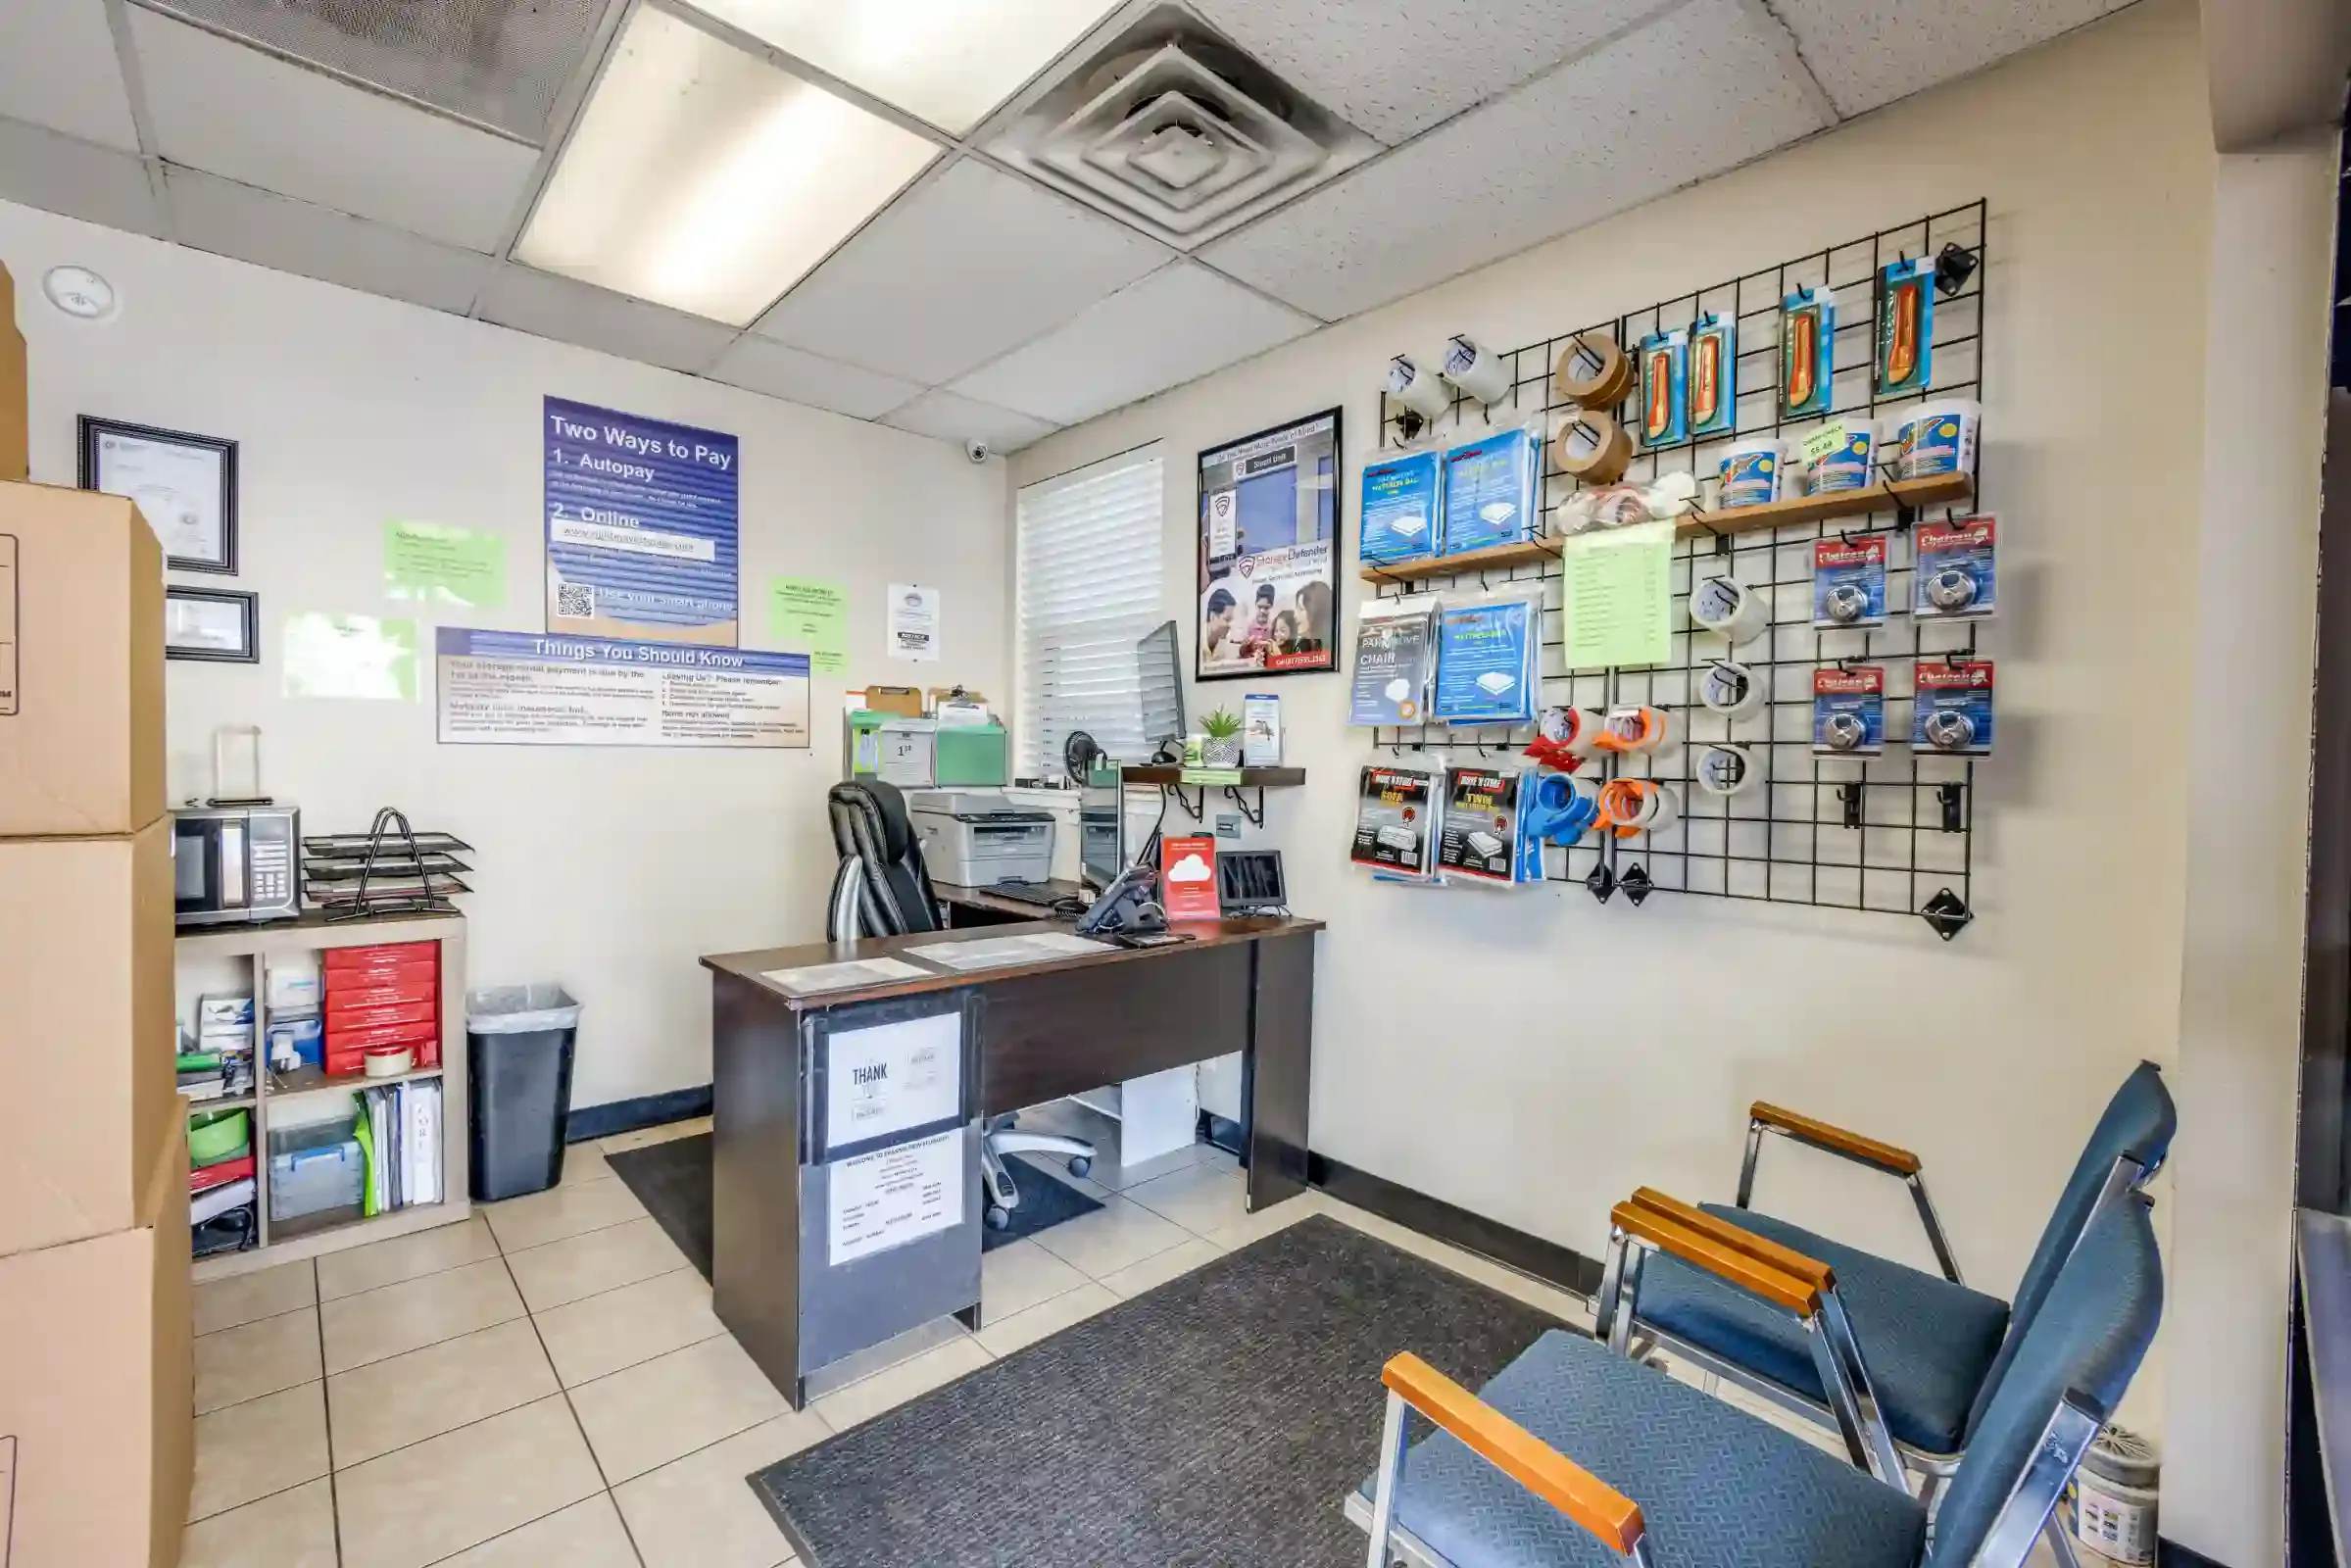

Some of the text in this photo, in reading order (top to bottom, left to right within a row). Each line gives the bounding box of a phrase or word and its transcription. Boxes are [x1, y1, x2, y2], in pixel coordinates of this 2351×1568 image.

[550, 415, 731, 470] Two Ways to Pay
[553, 448, 655, 482] 1. Autopay
[553, 503, 640, 528] 2. Online
[533, 638, 745, 668] Things You Should Know
[1360, 652, 1396, 664] CHAIR
[546, 666, 587, 676] payment
[617, 669, 629, 679] by
[630, 669, 645, 679] the
[1465, 793, 1494, 806] TWIN
[852, 1062, 888, 1085] THANK
